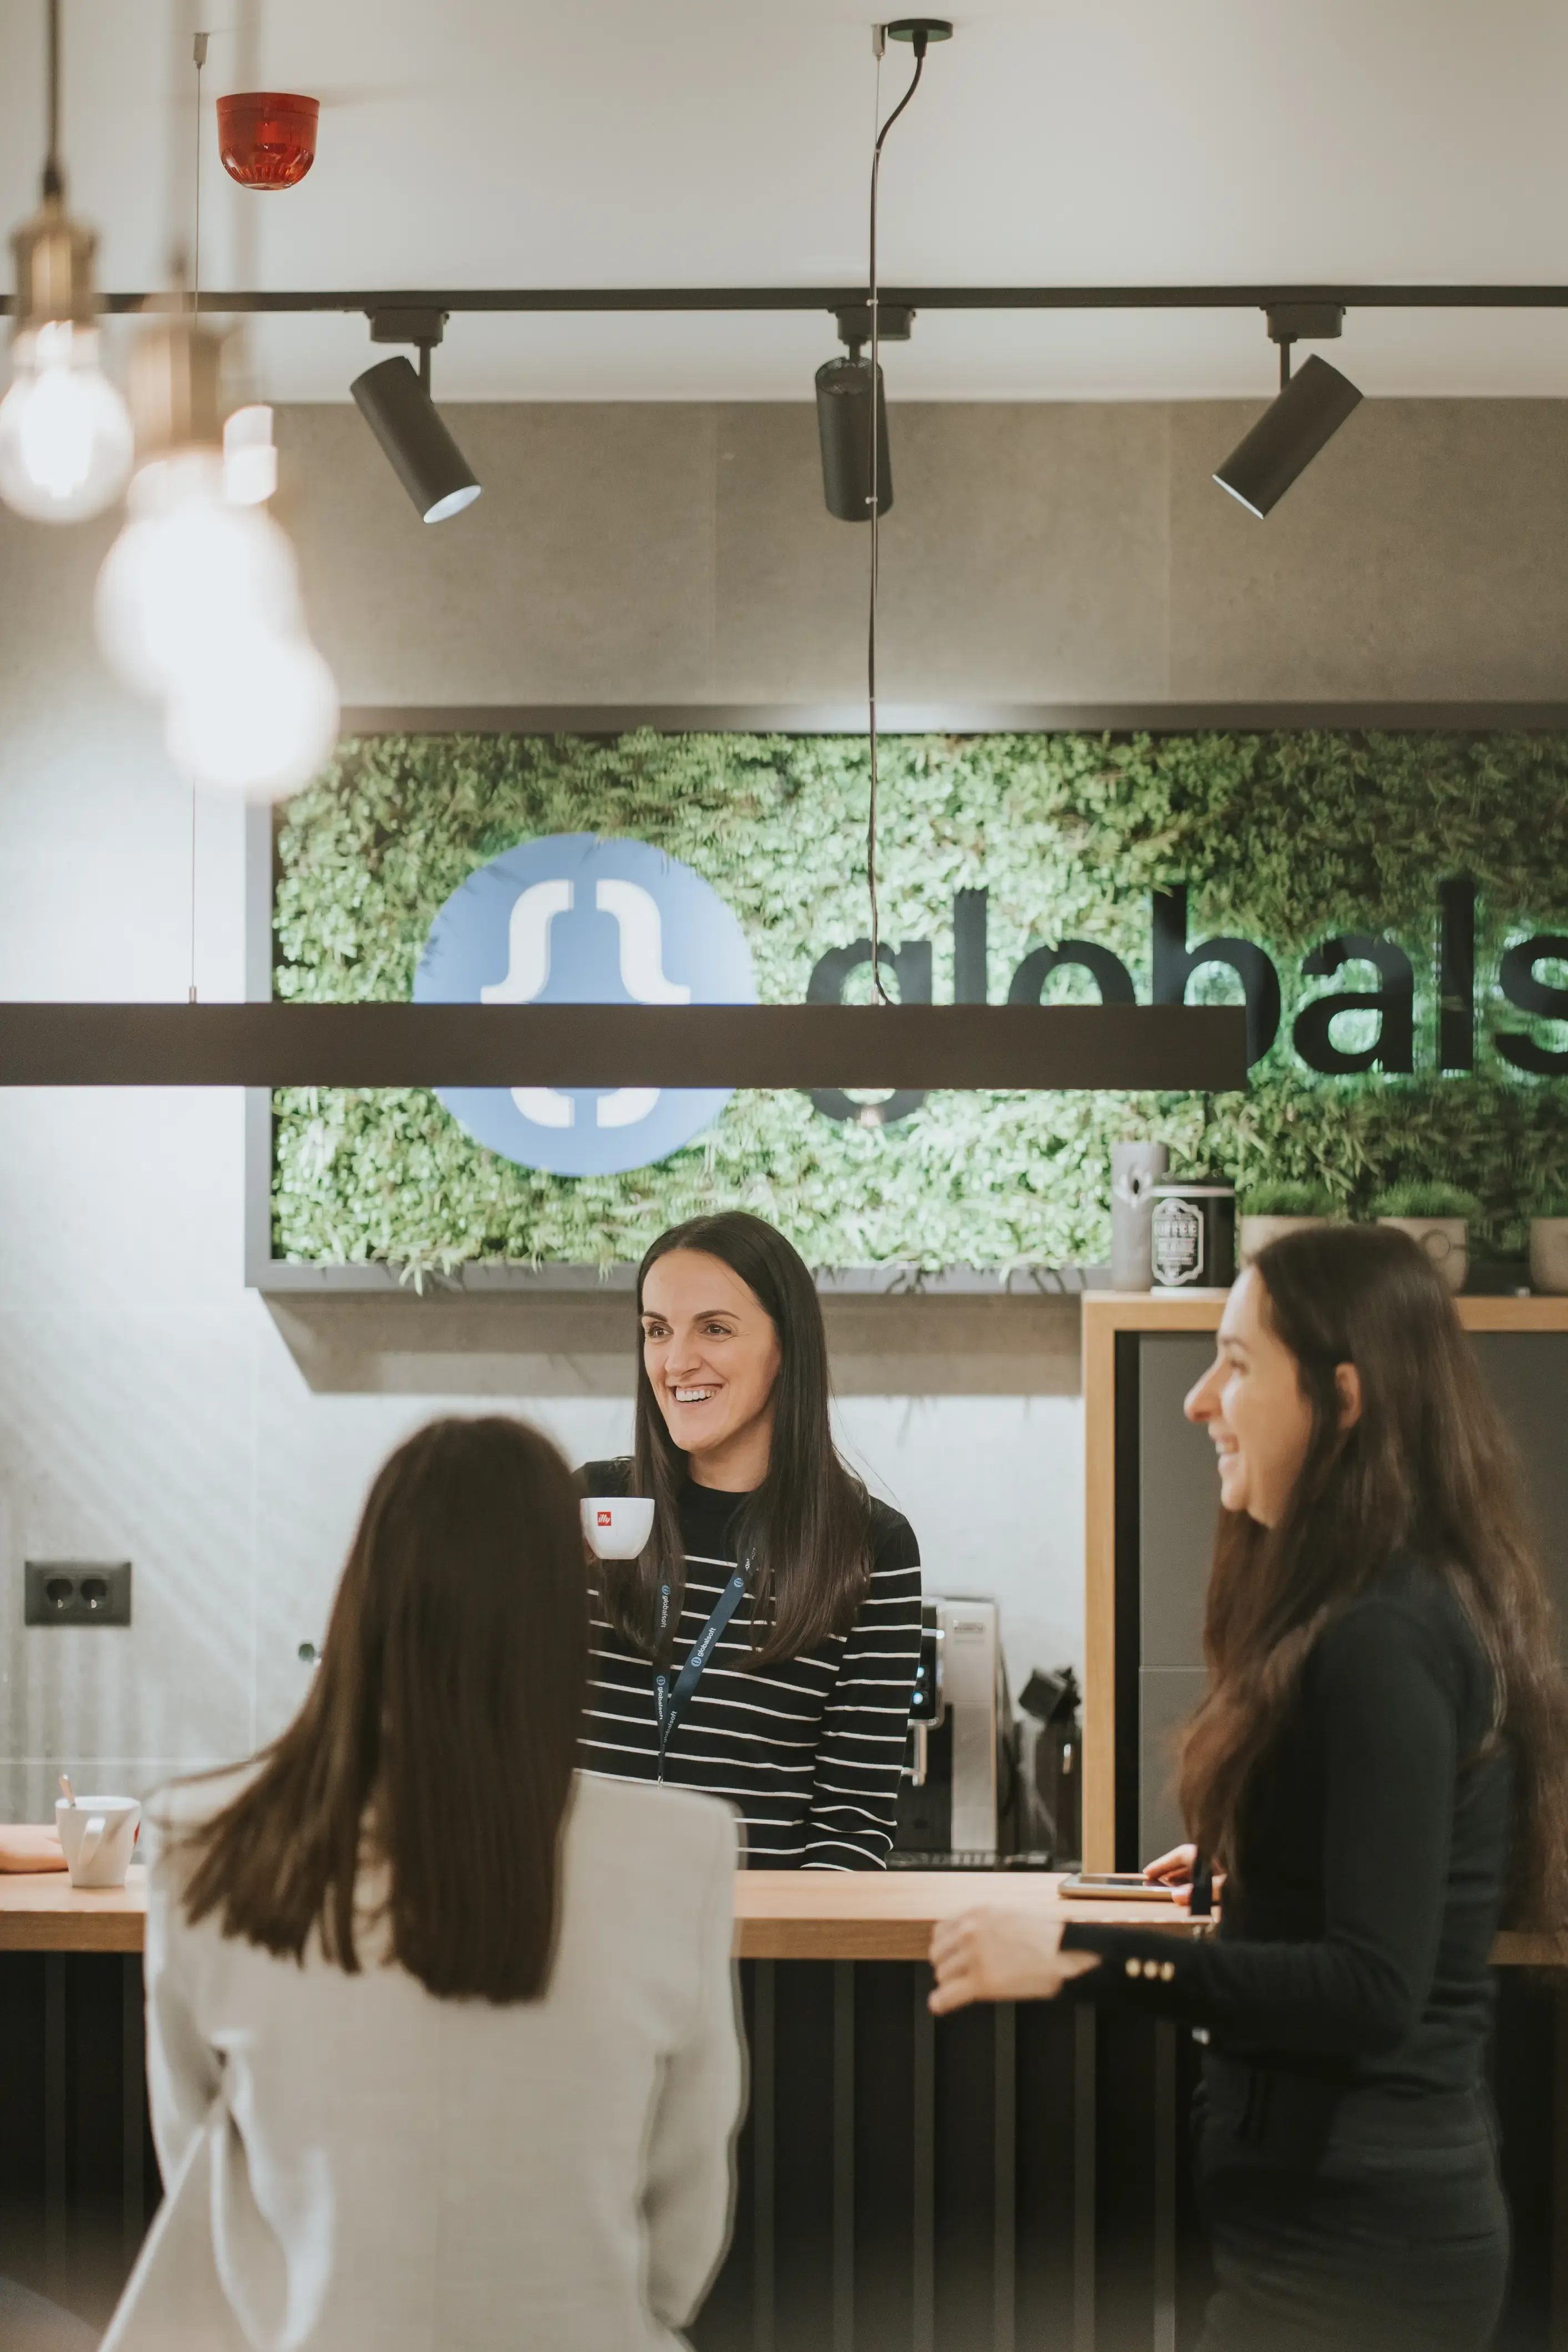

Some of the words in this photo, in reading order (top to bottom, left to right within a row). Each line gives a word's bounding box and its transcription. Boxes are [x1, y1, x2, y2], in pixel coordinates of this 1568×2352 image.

[599, 1514, 610, 1525] illy
[661, 1595, 669, 1628] globalsoft
[698, 1627, 716, 1657] globalsoft
[663, 1710, 678, 1743] globalsoft
